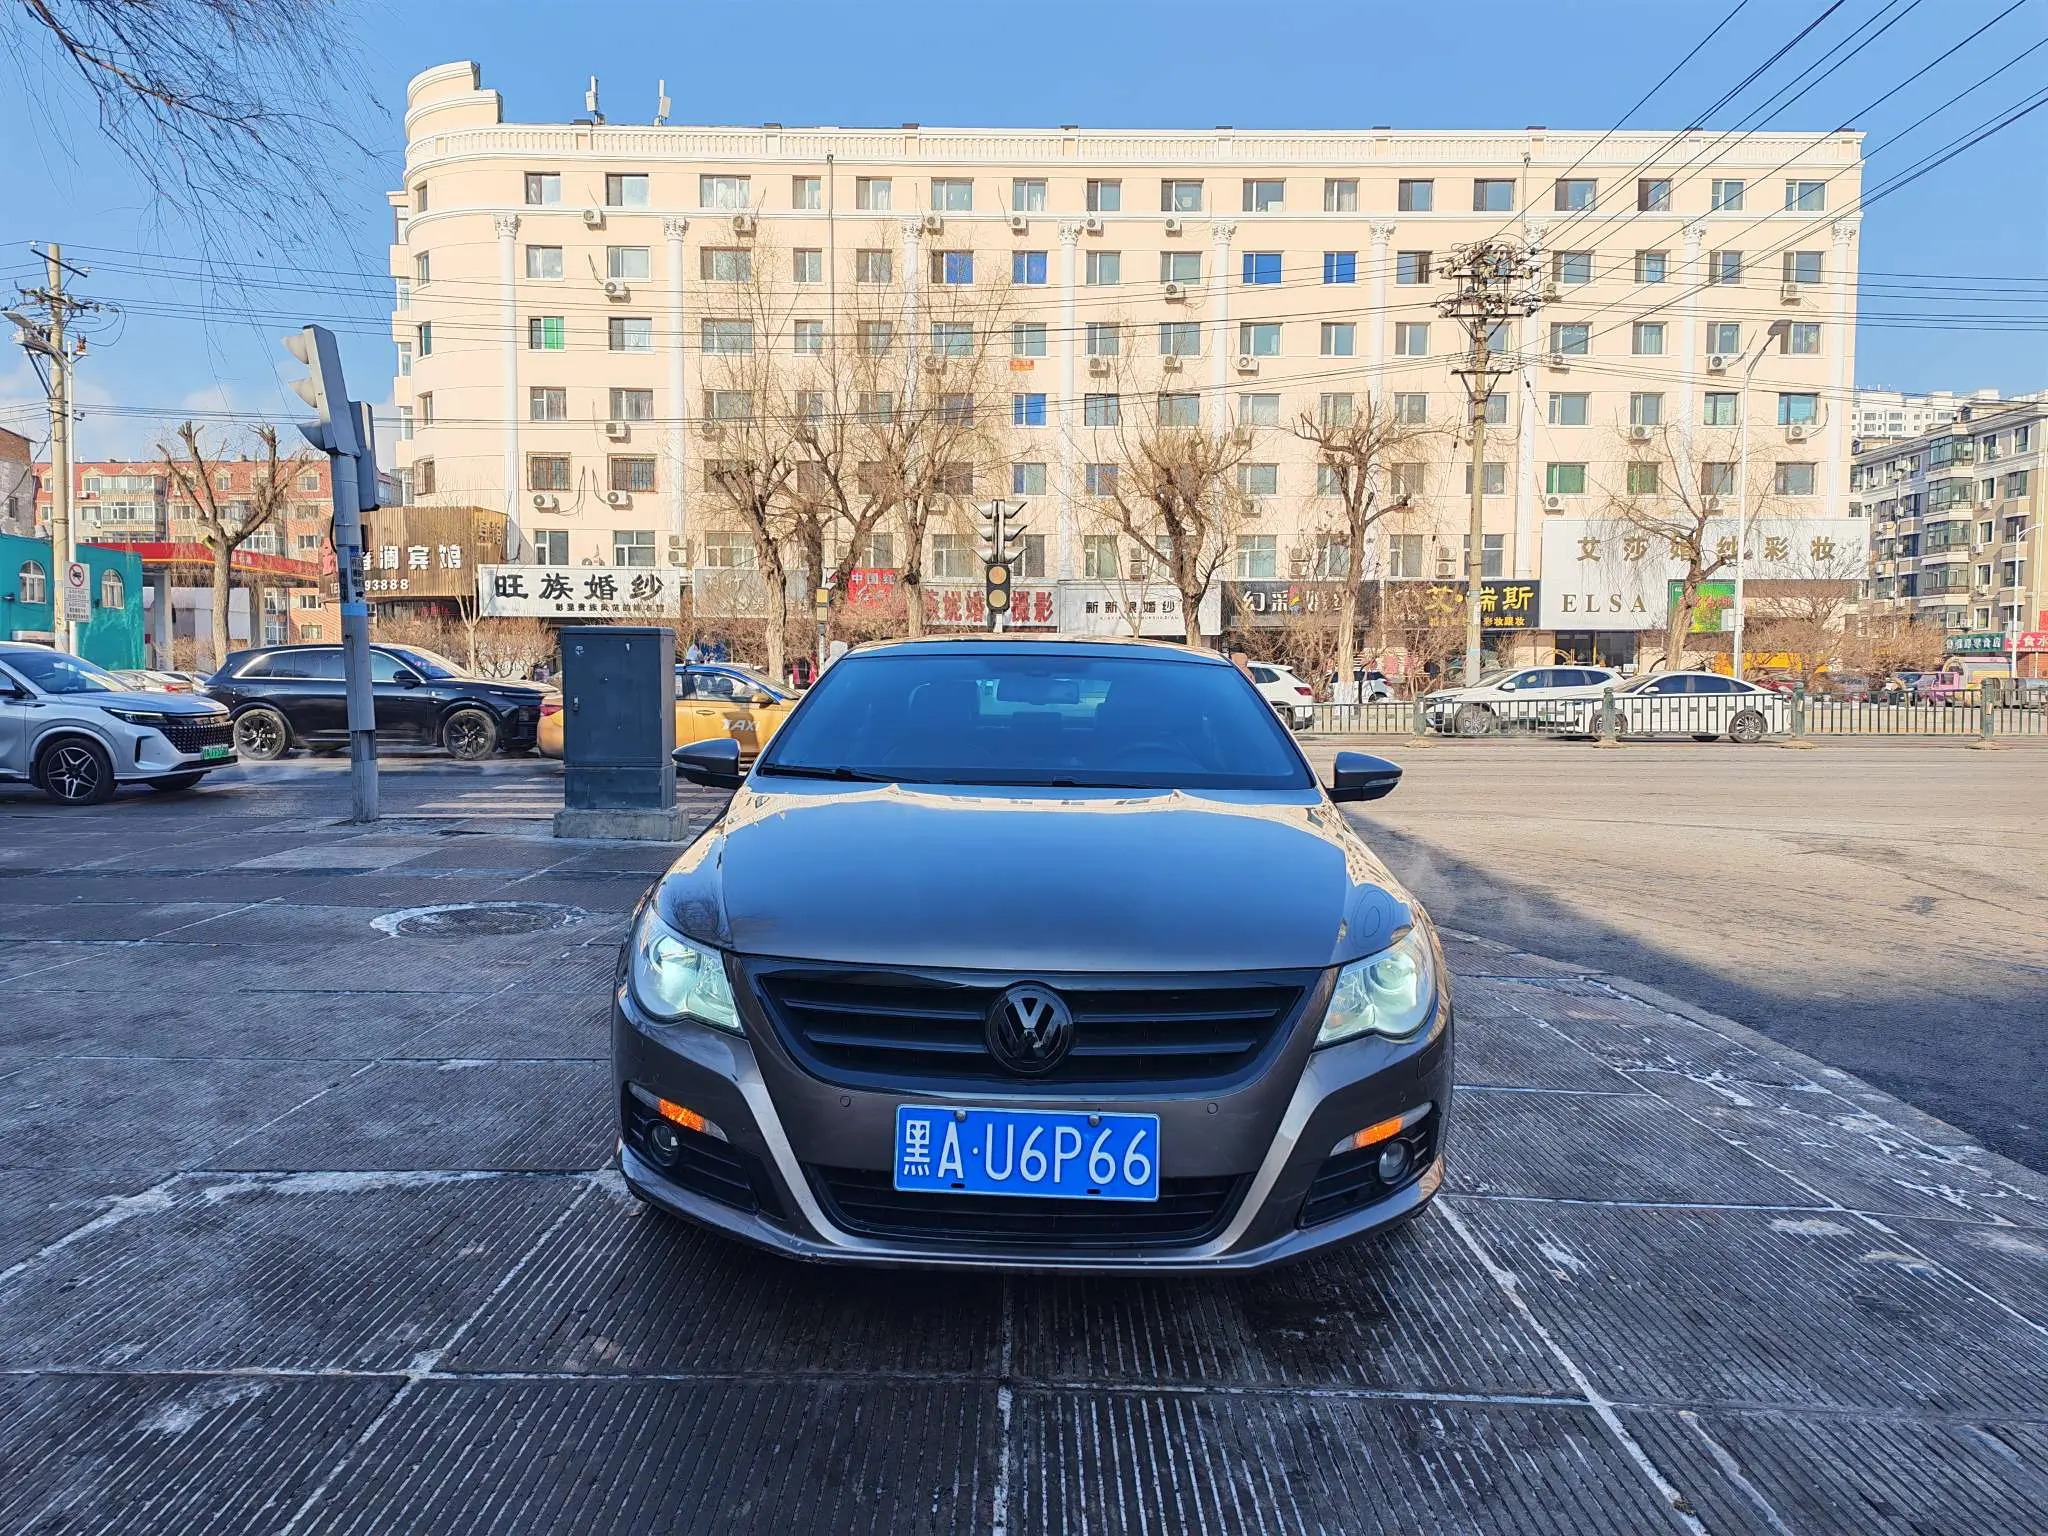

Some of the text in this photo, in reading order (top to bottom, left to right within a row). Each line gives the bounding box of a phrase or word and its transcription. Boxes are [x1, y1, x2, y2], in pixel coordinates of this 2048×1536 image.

[494, 572, 664, 600] 旺族婚纱
[1561, 593, 1648, 613] ELSA
[903, 1118, 1152, 1186] 黑A·U6P66
